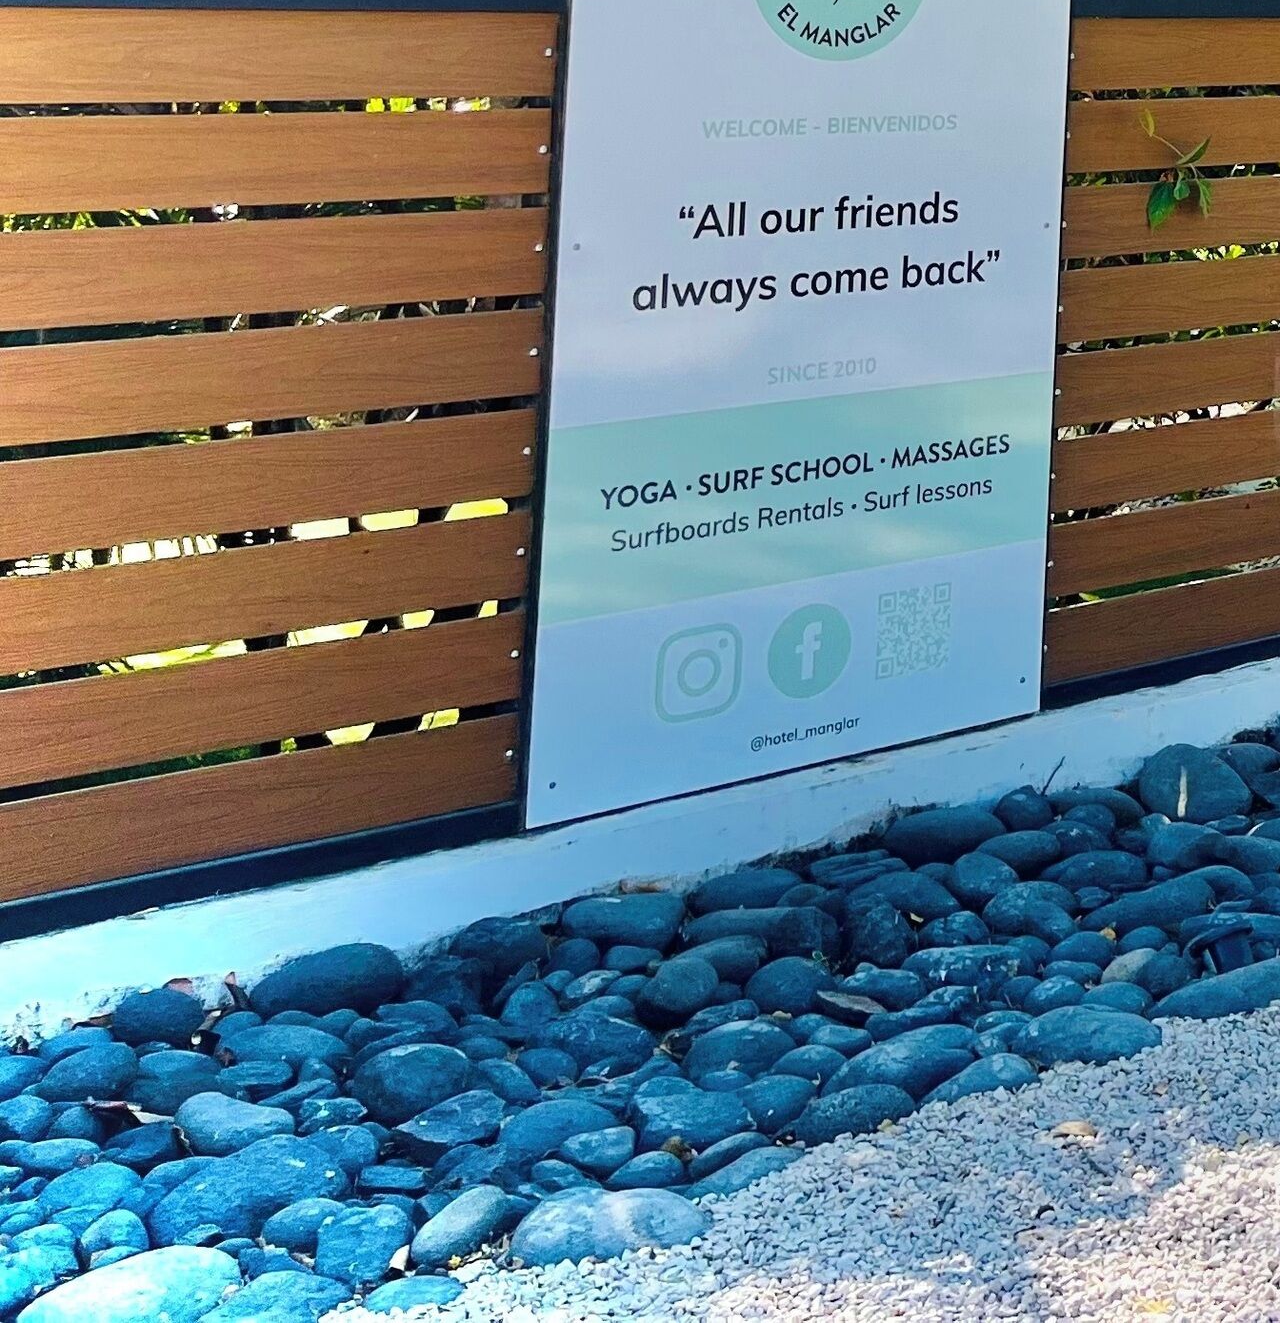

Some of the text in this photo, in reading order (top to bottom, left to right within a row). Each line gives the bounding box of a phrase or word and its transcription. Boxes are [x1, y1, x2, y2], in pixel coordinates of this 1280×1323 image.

[777, 2, 901, 47] EL MANGLAR
[702, 118, 808, 139] WELCOME
[828, 114, 958, 134] BIENVENIDOS
[679, 191, 959, 239] “All our friends
[632, 249, 1000, 312] always come back”
[767, 357, 877, 385] SINCE 2010
[600, 479, 677, 510] YOGA
[698, 466, 766, 496] SURF
[770, 452, 874, 486] SCHOOL
[891, 433, 1010, 469] MASSAGES
[611, 511, 750, 551] Surfboards
[758, 497, 844, 529] Rentals
[863, 485, 910, 513] Surf
[916, 478, 993, 504] lessons
[750, 717, 860, 752] @hotel_manglar
